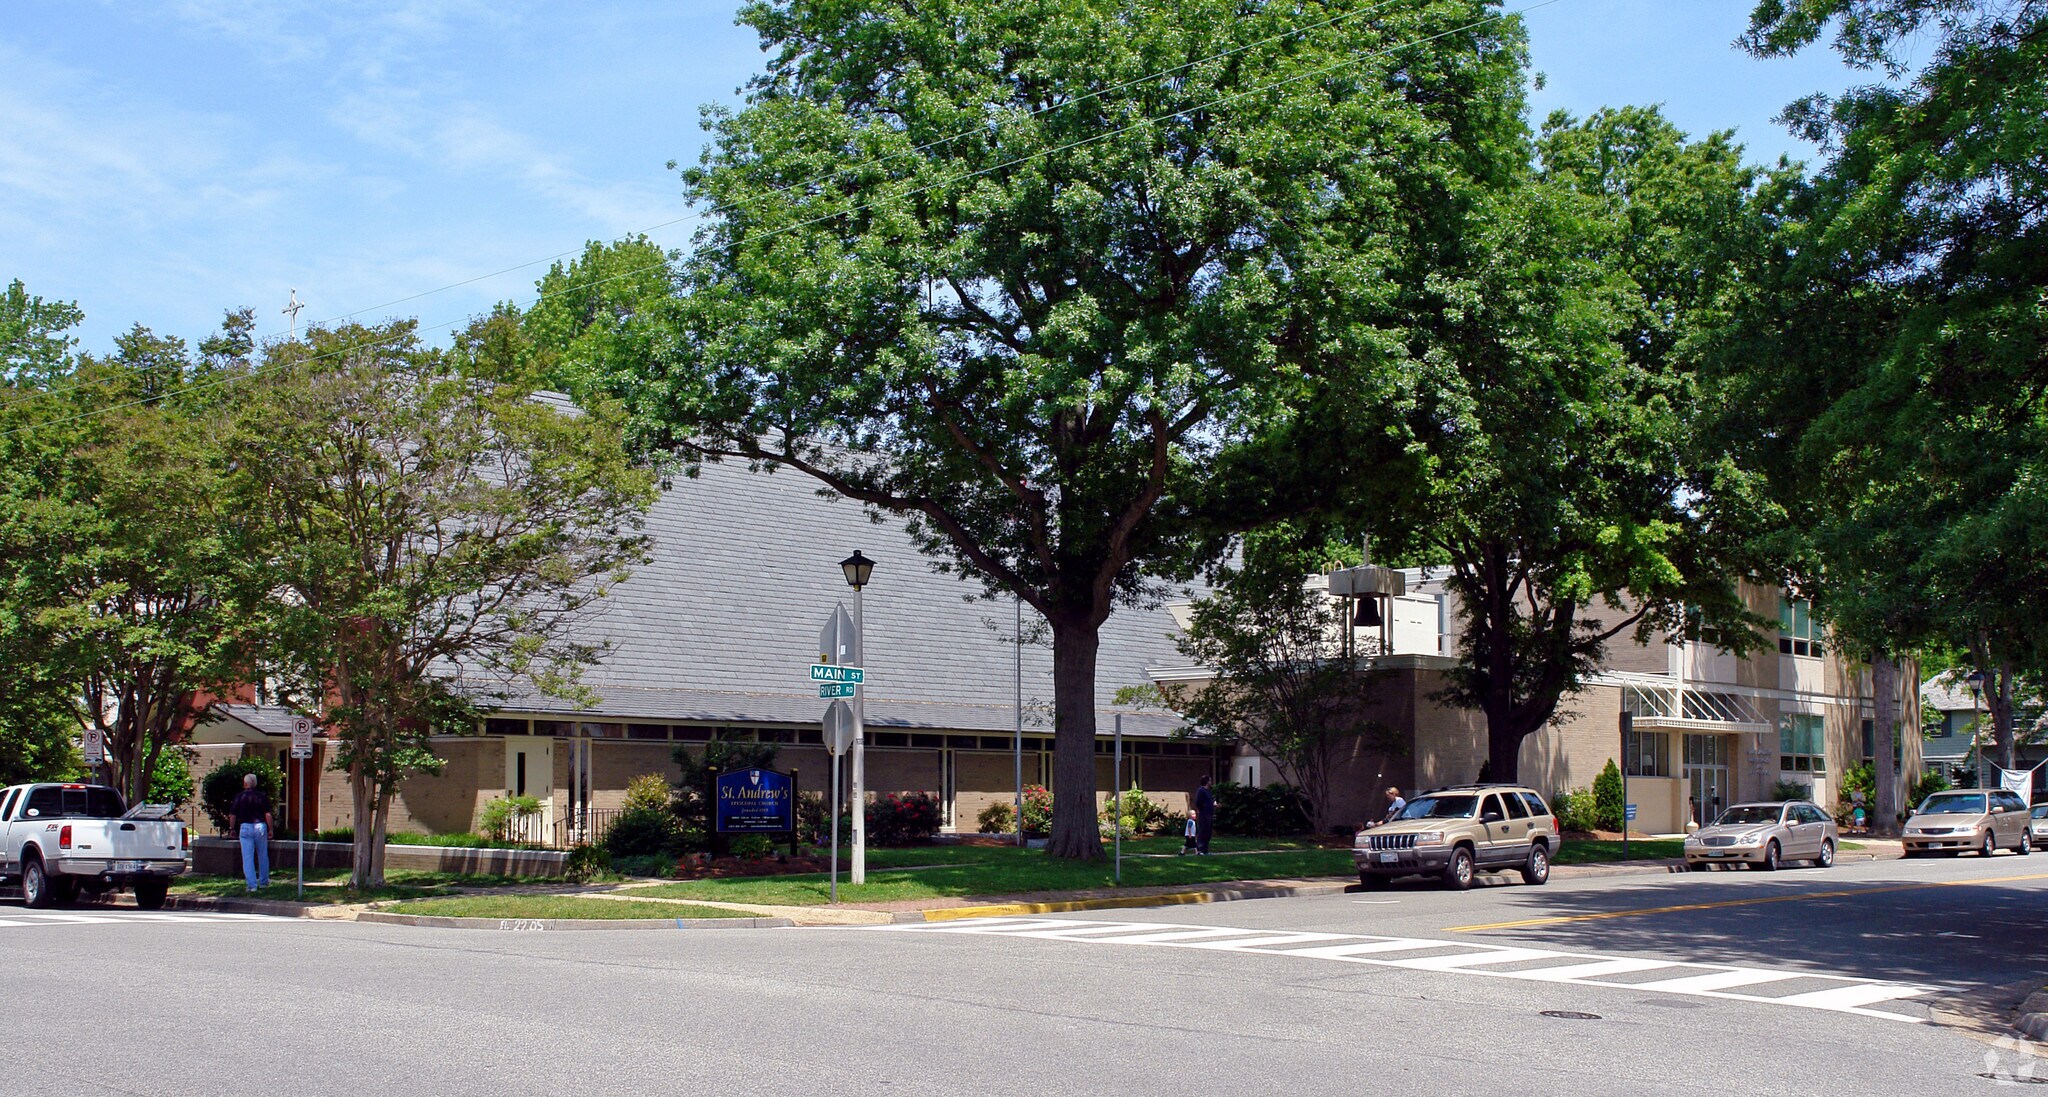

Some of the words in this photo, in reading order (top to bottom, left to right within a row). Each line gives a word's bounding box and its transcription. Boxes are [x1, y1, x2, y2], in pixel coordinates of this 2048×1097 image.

[814, 668, 846, 680] MAIN
[851, 672, 861, 680] ST
[820, 685, 841, 696] RIVER
[845, 686, 853, 694] RD
[721, 785, 735, 799] St.
[738, 784, 788, 799] Andrew's
